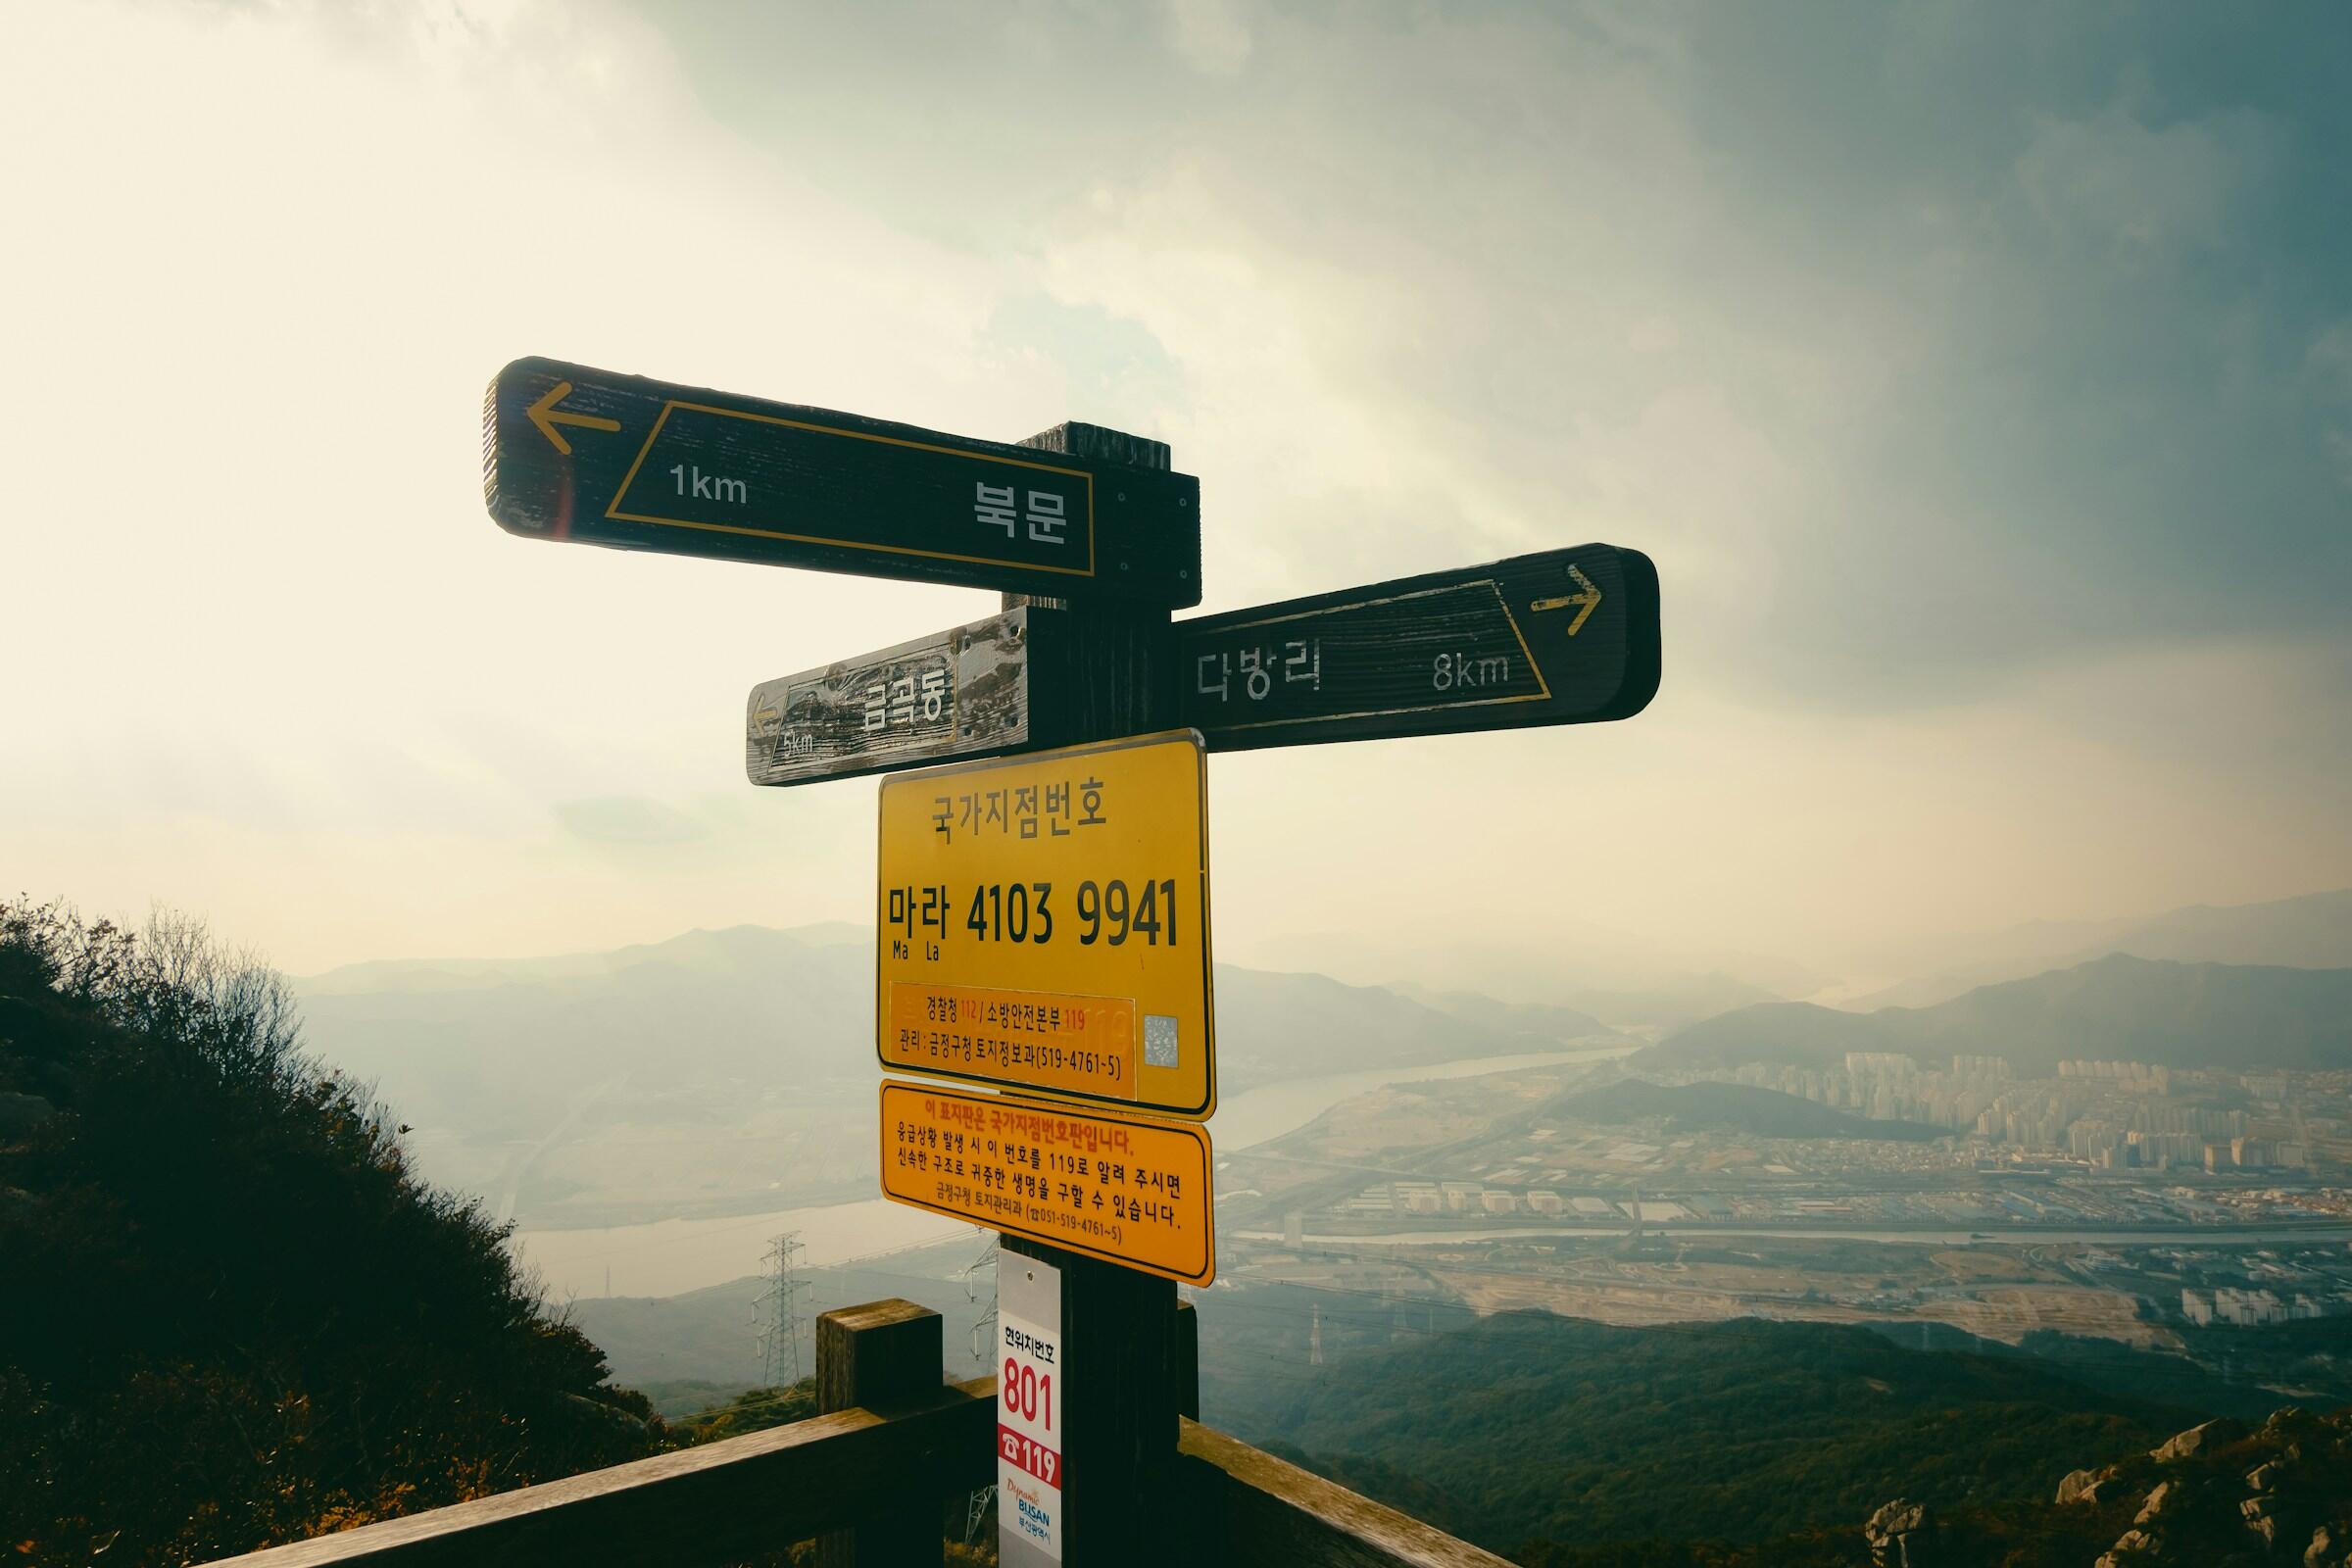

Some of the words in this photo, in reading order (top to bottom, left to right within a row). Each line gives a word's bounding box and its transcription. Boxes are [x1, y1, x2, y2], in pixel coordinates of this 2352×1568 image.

[669, 465, 748, 505] 1km
[973, 480, 1068, 545] 북문
[1197, 638, 1321, 702] 다방리
[1432, 652, 1509, 692] 8km
[864, 668, 946, 732] 금곡동
[783, 729, 813, 758] 5km
[932, 776, 1107, 845] 국가지점번호
[889, 884, 951, 940] 마라
[966, 882, 1053, 945] 4103
[1076, 878, 1177, 947] 9941
[893, 940, 908, 960] Ma
[926, 941, 939, 961] La
[926, 995, 957, 1024] 경찰청
[987, 1001, 1061, 1033] 소방안전본부
[1065, 1008, 1085, 1031] 119
[929, 1031, 971, 1062] 금정구청
[925, 1099, 936, 1120] 이
[941, 1101, 987, 1132] 표지판은
[990, 1109, 1135, 1157] 국가지점번호판입니다.
[897, 1121, 937, 1150] 응급상황
[943, 1131, 964, 1154] 발생
[970, 1137, 980, 1154] 시
[987, 1140, 998, 1158] 이
[1004, 1141, 1041, 1170] 번호를
[1050, 1152, 1090, 1176] 119로
[1098, 1160, 1125, 1186] 알려
[1135, 1168, 1181, 1200] 주시면
[898, 1147, 927, 1172] 신속한
[933, 1155, 965, 1177] 구조로
[971, 1163, 1005, 1191] 귀중한
[1012, 1170, 1049, 1200] 생명을
[1057, 1183, 1083, 1209] 구할
[1092, 1190, 1104, 1211] 수
[1113, 1194, 1181, 1230] 있습니다.
[936, 1181, 971, 1208] 금정구청
[974, 1192, 1022, 1218] 토지관리과
[1004, 1325, 1055, 1365] 현위치번호
[1004, 1356, 1051, 1432] 801
[1022, 1440, 1055, 1484] 119
[1007, 1477, 1040, 1506] Dynamic
[1018, 1497, 1051, 1528] BUSAN
